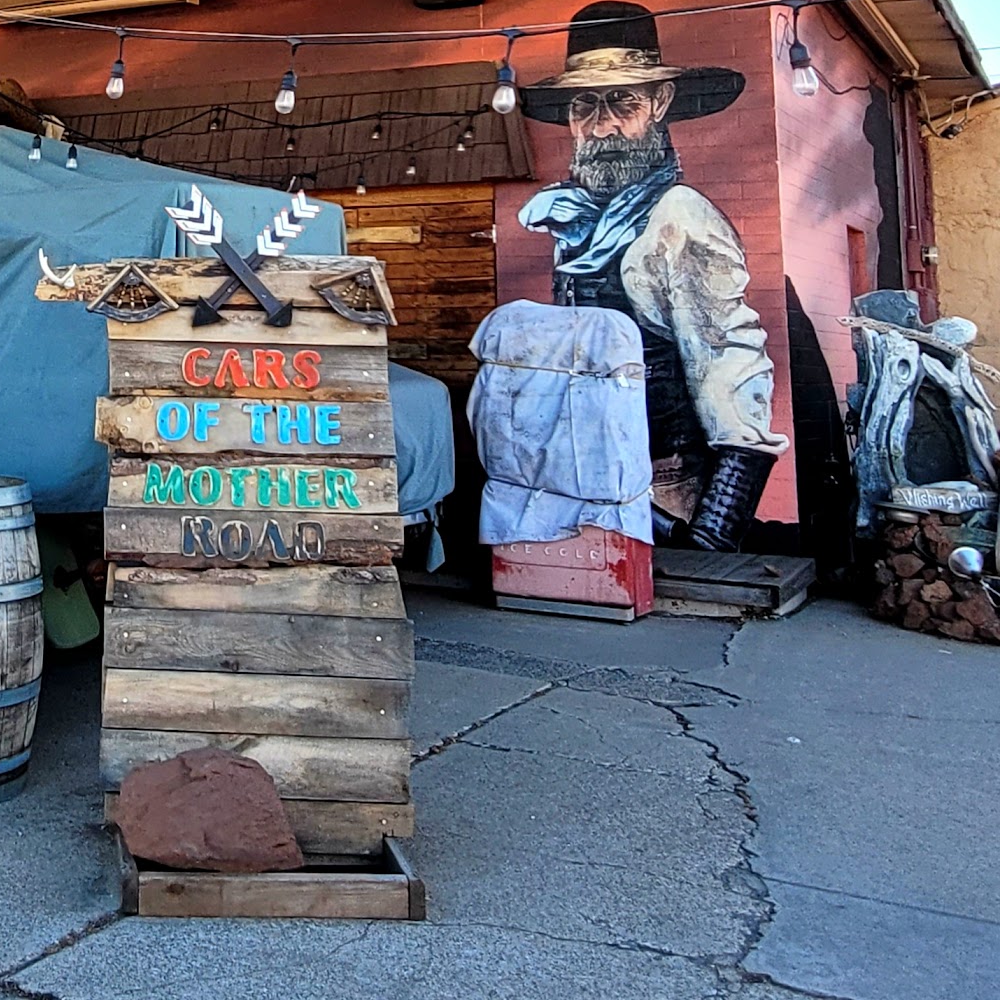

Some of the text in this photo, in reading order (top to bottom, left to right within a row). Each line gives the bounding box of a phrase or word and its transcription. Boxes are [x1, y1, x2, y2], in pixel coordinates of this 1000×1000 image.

[181, 347, 323, 390] CARS
[155, 401, 342, 445] OF THE
[142, 462, 362, 509] MOTHER
[896, 488, 954, 512] Wishing
[180, 515, 327, 561] ROAD
